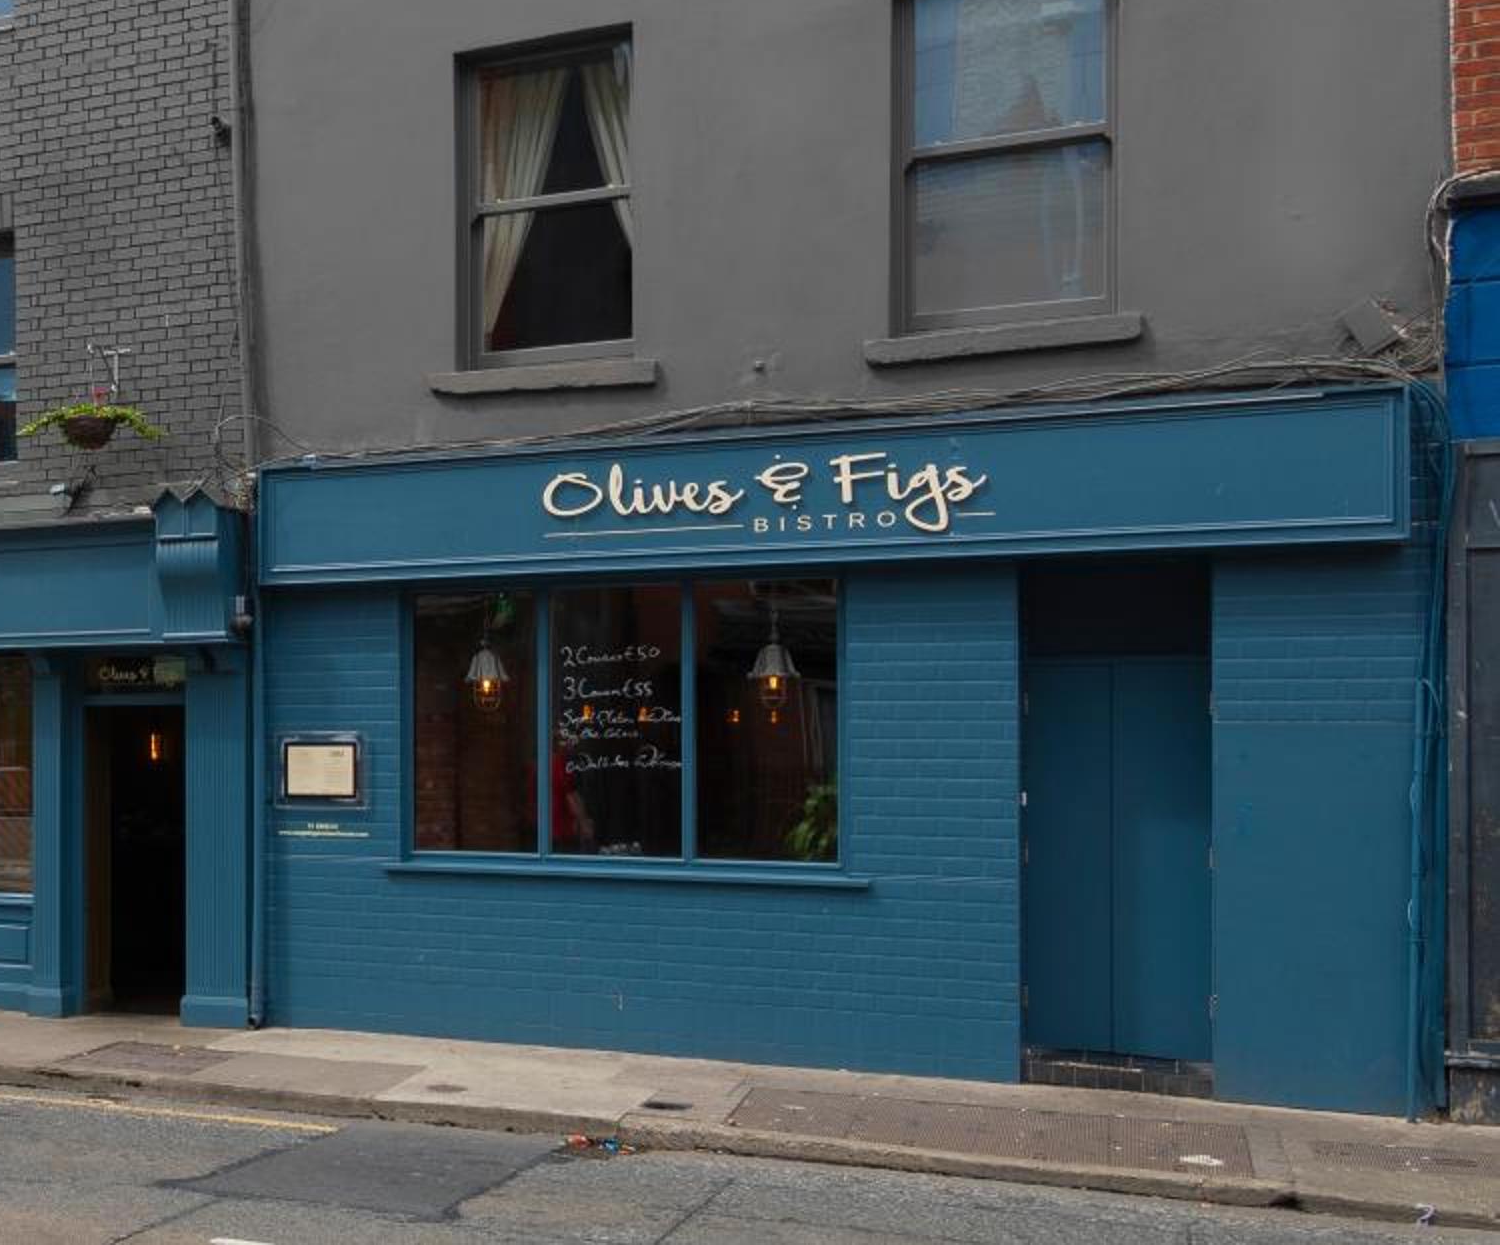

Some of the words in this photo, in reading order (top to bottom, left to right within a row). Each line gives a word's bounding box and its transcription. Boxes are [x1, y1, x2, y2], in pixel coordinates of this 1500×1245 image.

[542, 462, 745, 517] Olives
[755, 454, 810, 510] &
[829, 451, 988, 532] Figs
[753, 511, 898, 534] BISTRO
